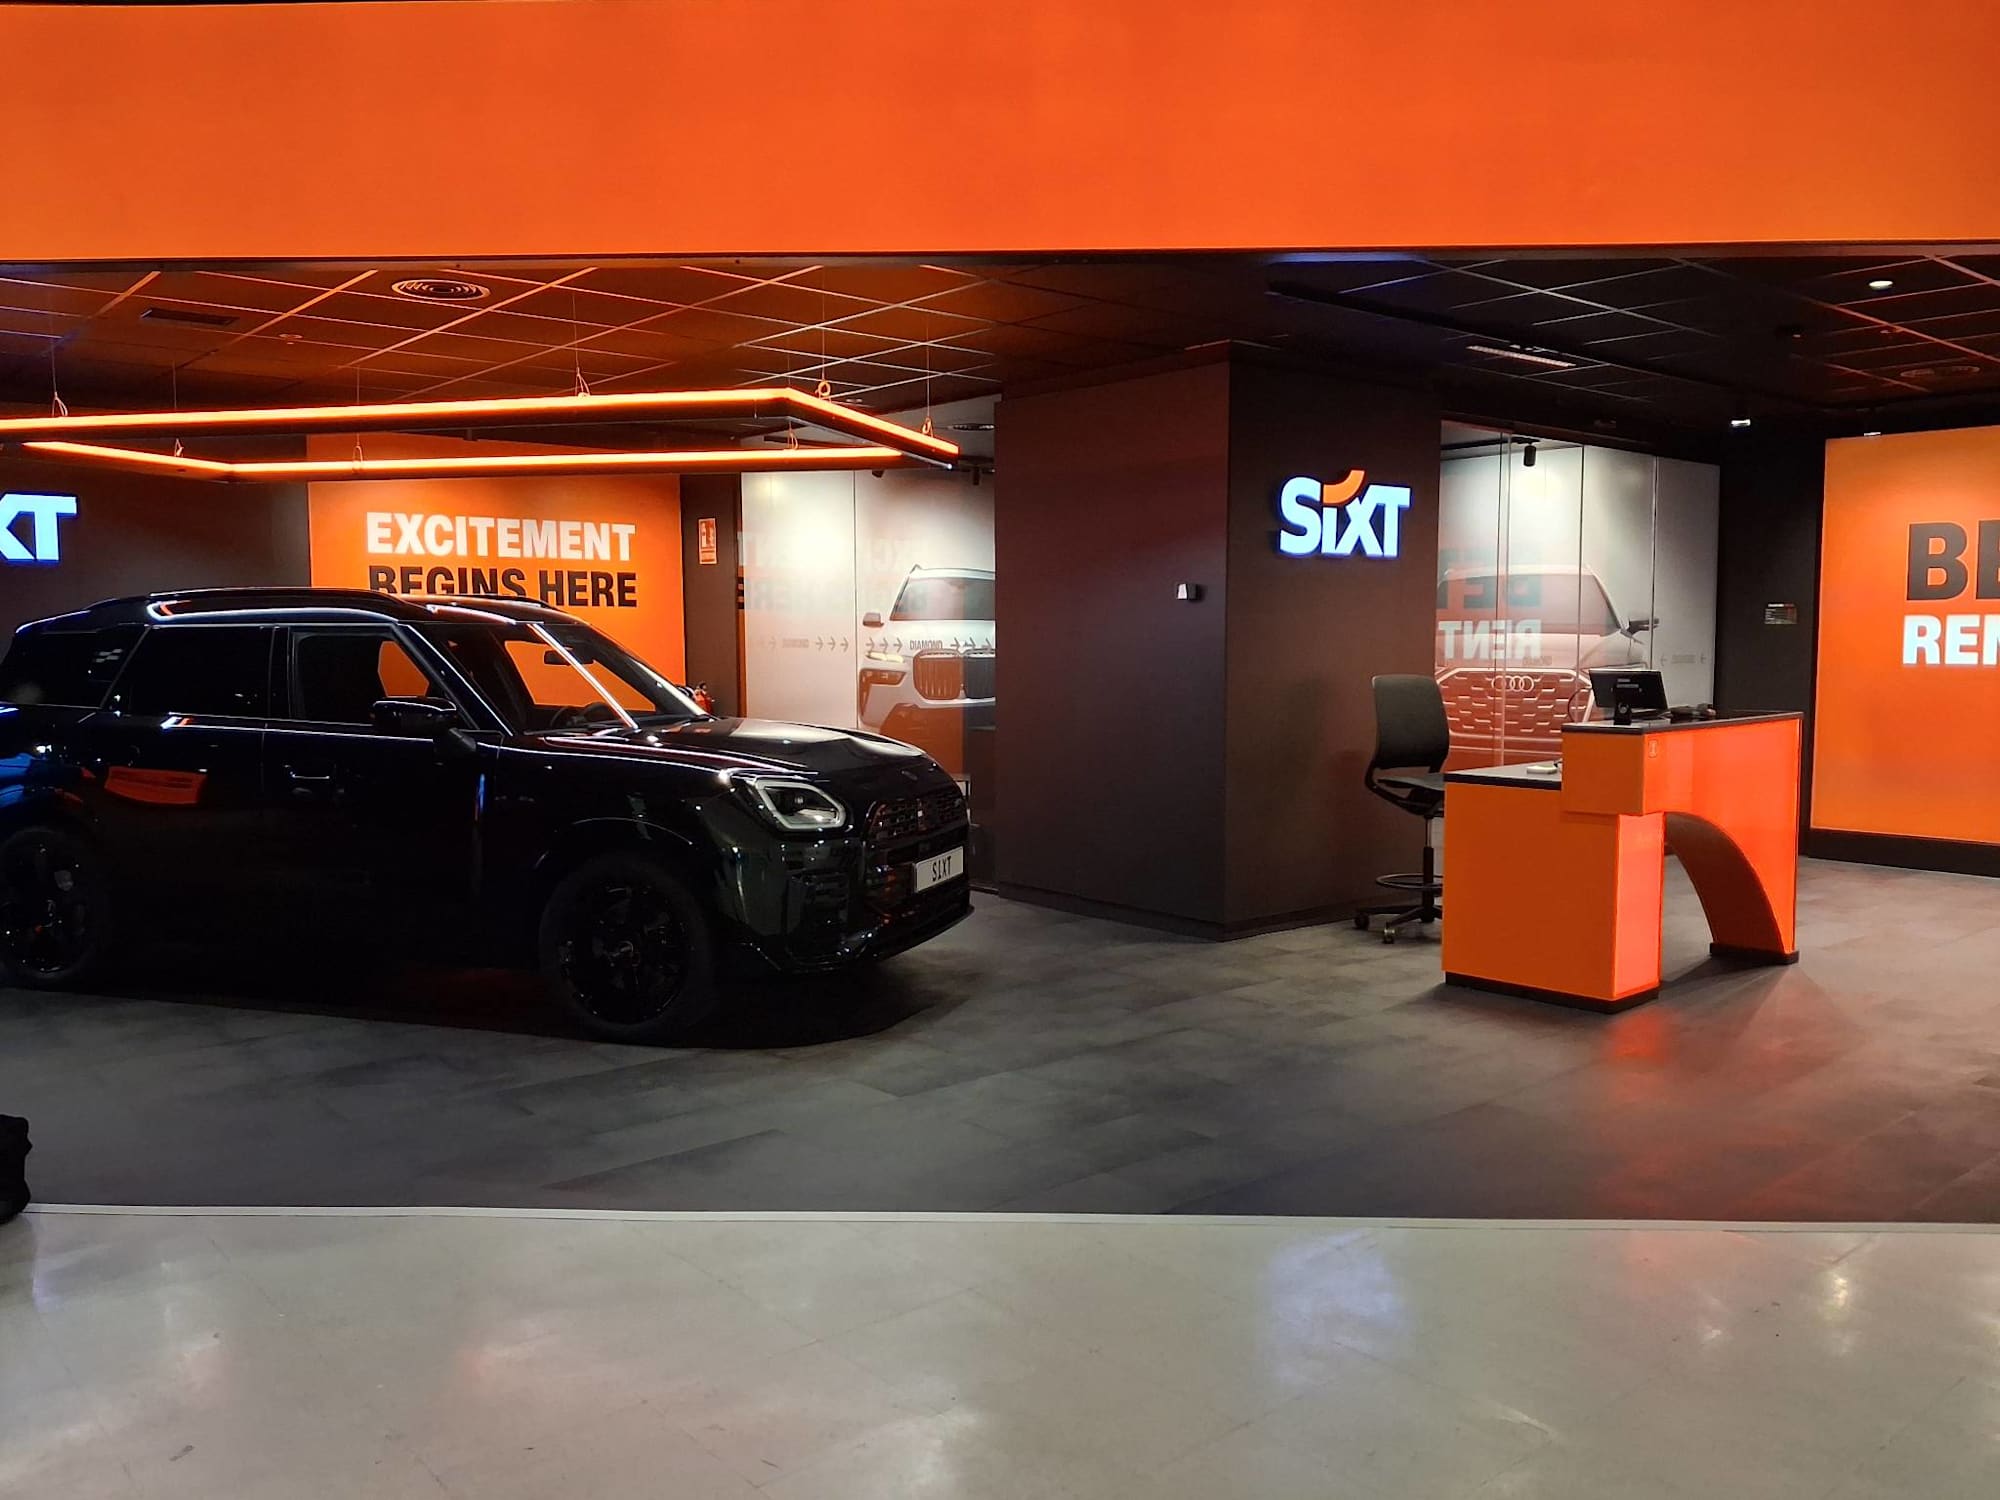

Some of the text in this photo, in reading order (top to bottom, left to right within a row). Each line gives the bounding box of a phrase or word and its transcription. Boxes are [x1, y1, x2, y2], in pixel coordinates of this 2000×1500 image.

[366, 511, 636, 561] EXCITEMENT
[369, 565, 637, 608] BEGINS HERE
[932, 855, 952, 882] SIXT
